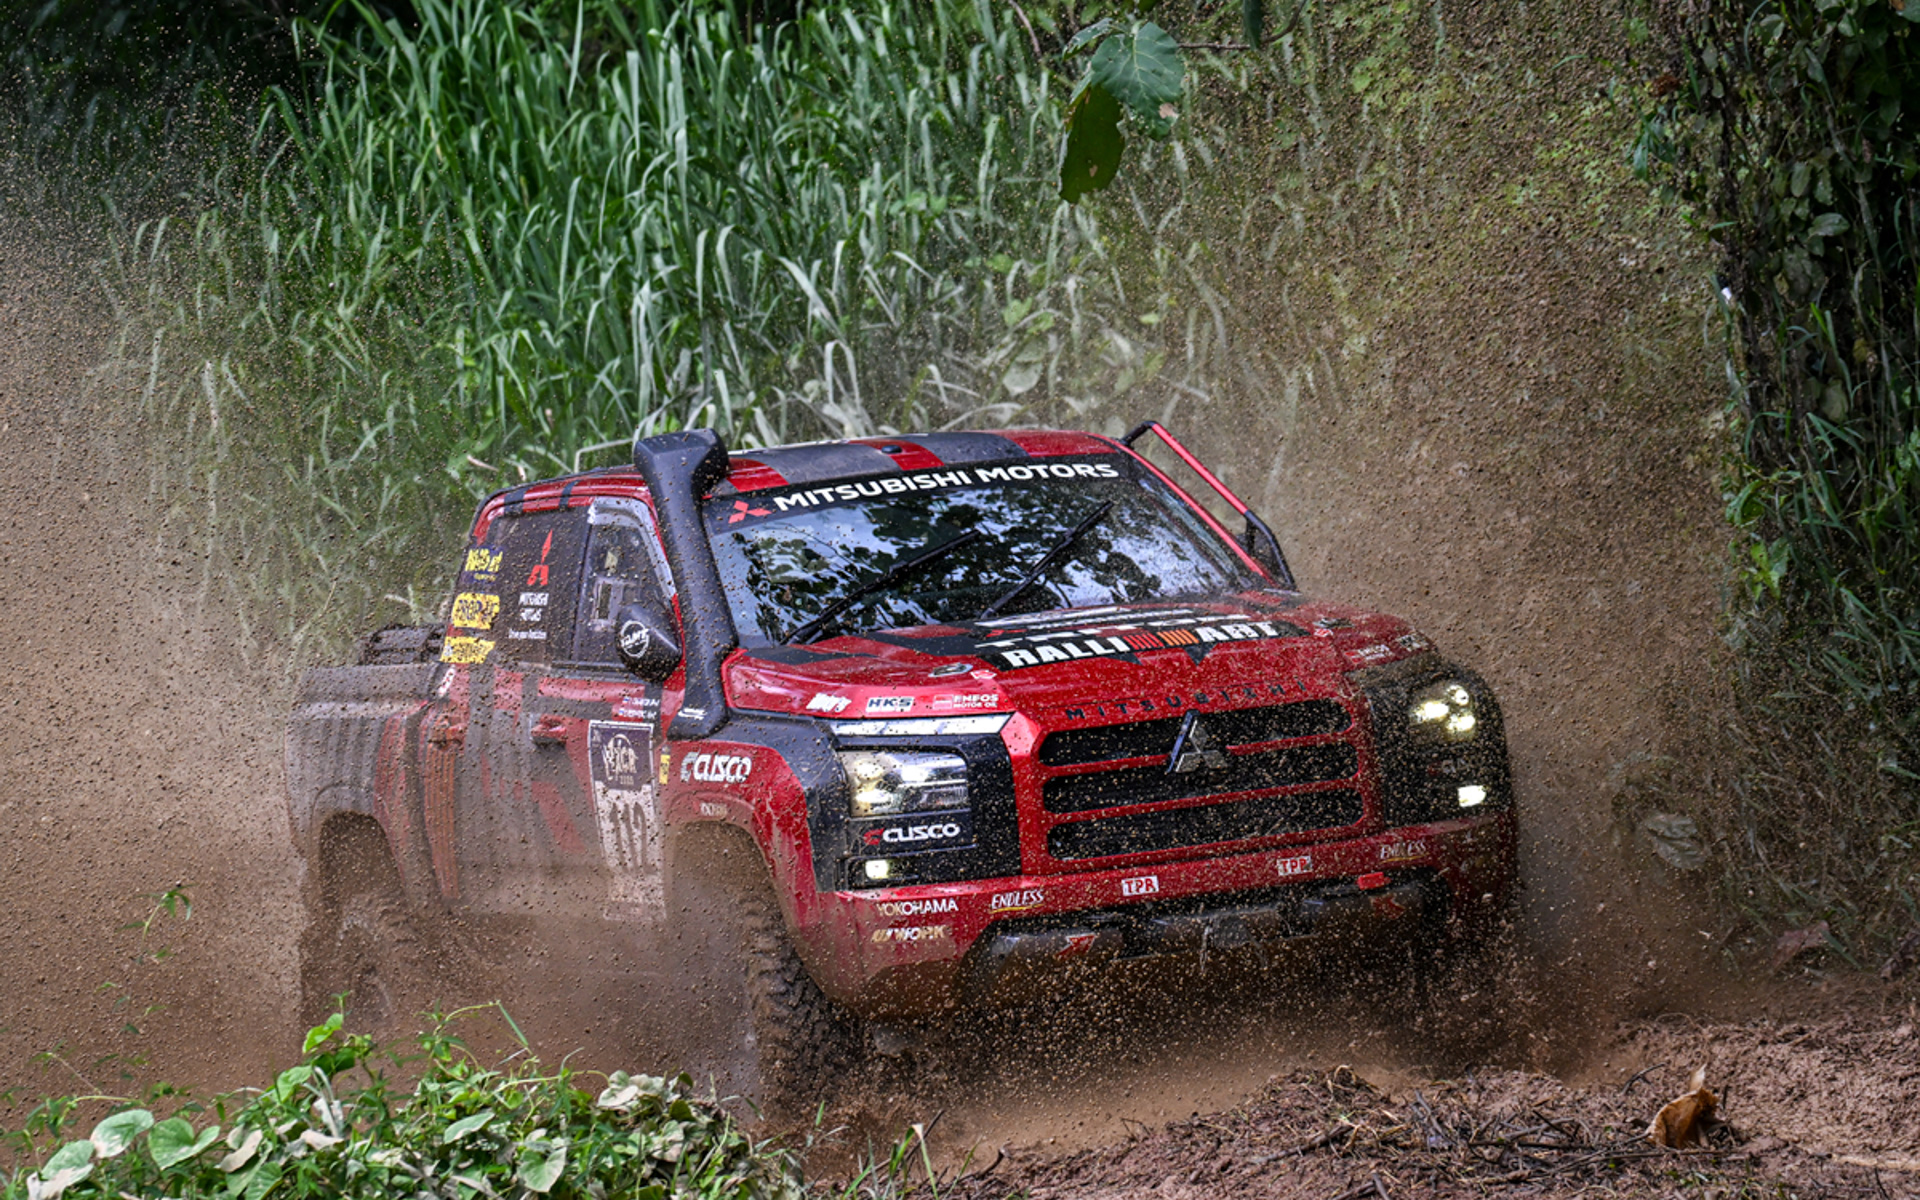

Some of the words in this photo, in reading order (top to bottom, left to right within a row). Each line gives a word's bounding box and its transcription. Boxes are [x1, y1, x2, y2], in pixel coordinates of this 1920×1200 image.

[773, 469, 973, 511] MITSUBISHI
[977, 463, 1120, 484] MOTORS
[868, 697, 912, 708] HKS
[953, 693, 999, 702] ENEOS
[953, 701, 983, 709] MOTOR
[1065, 680, 1306, 721] MITSUBISHI
[692, 754, 752, 784] CUSCO
[882, 823, 961, 843] CUSCO
[1124, 876, 1158, 894] TPR
[877, 898, 959, 916] YOKOHAMA
[991, 888, 1045, 909] ENDLESS
